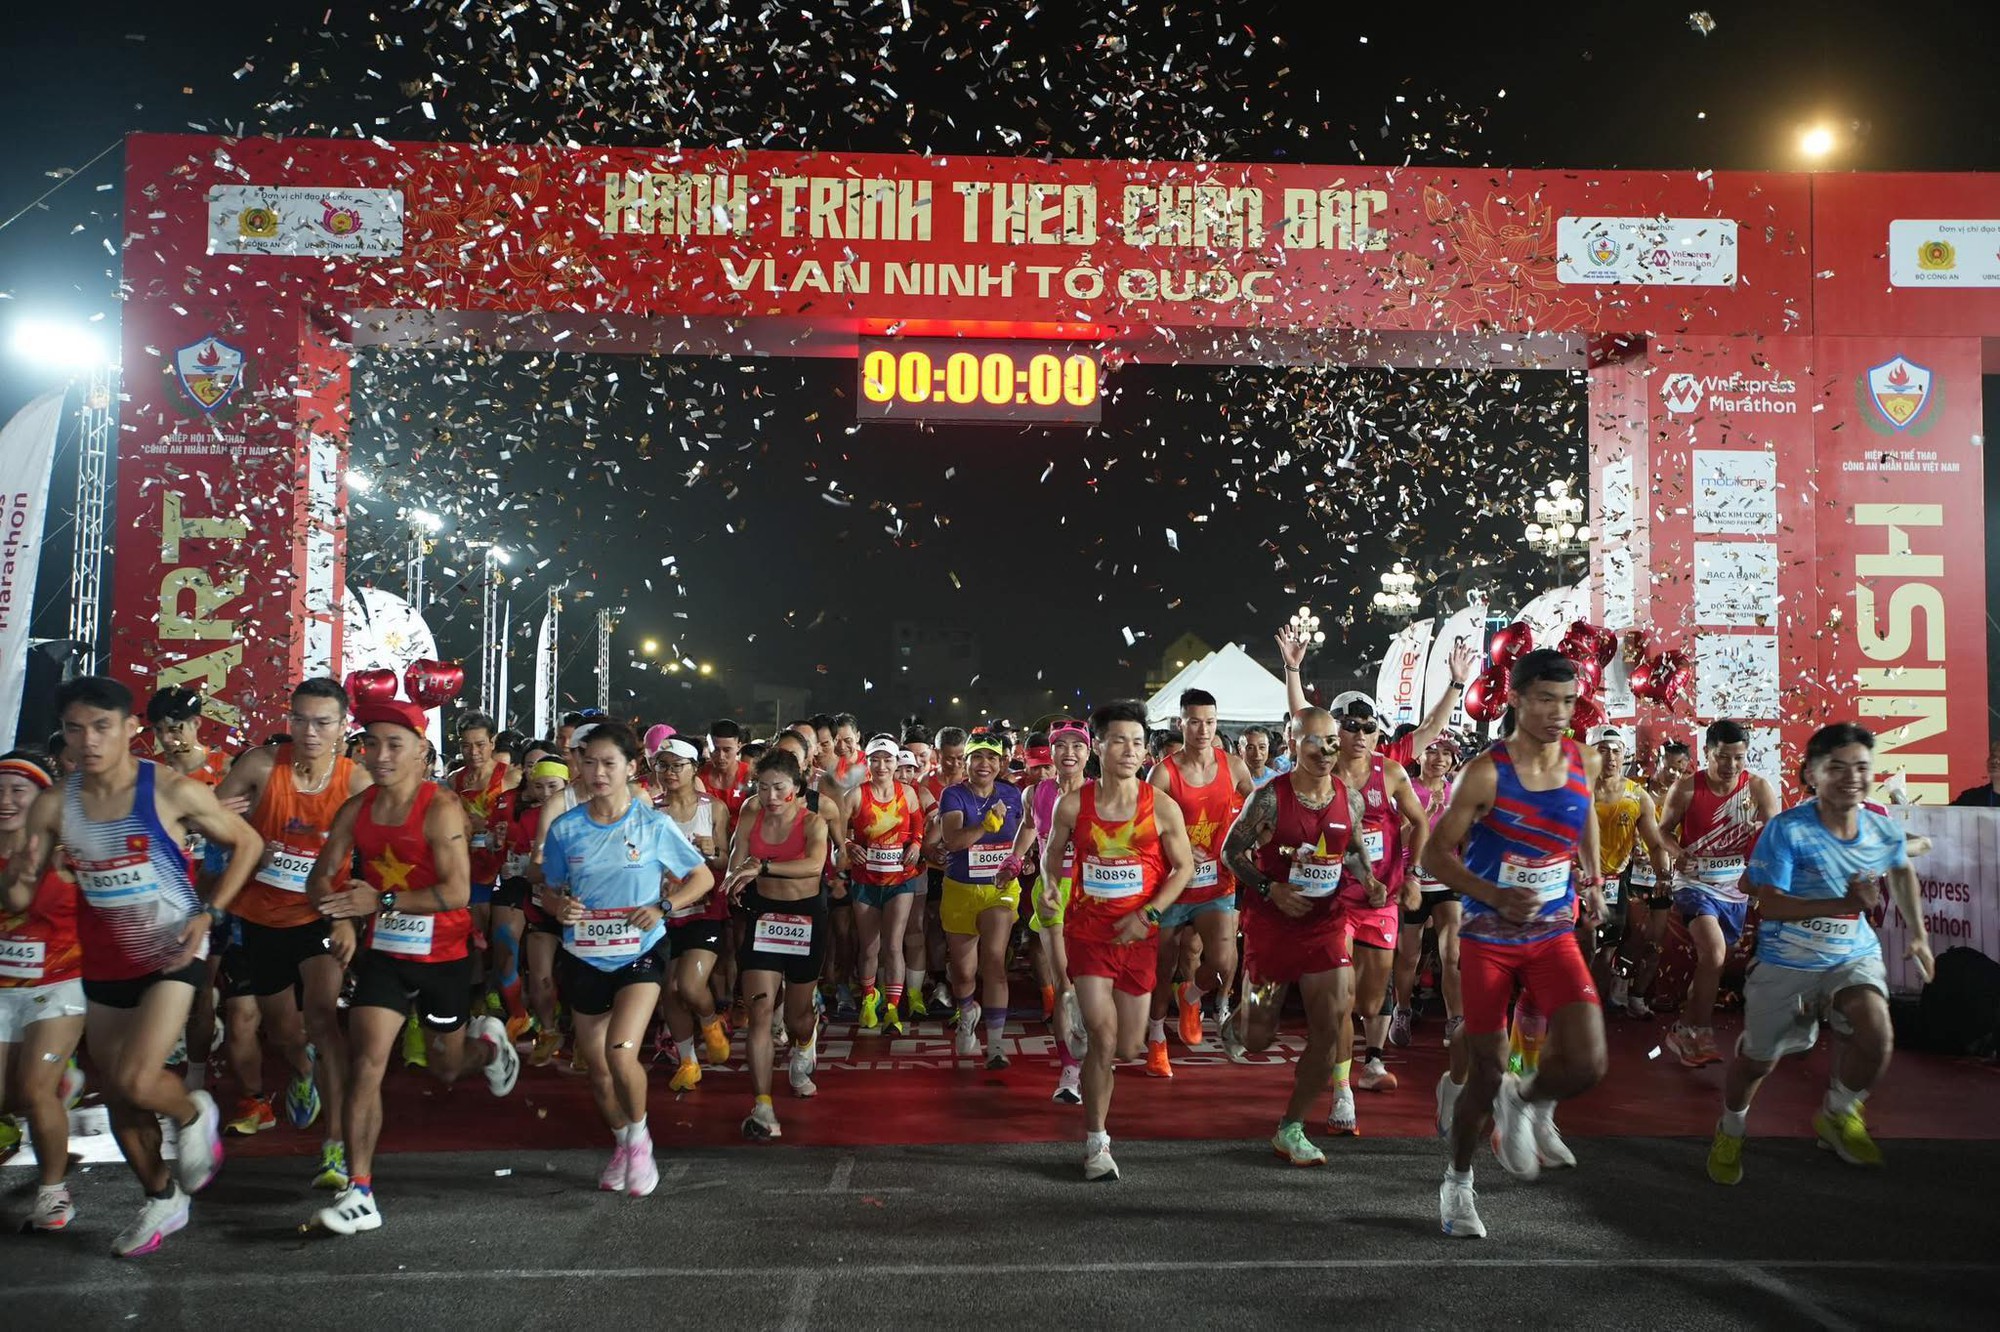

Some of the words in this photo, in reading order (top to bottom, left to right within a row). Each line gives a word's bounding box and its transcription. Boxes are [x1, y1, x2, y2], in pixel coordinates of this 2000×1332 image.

[770, 167, 933, 241] TRÌNH
[952, 181, 1097, 246] THEO
[1284, 178, 1388, 251] BÁC
[789, 260, 870, 294] AN
[884, 262, 1013, 297] NINH
[1026, 252, 1104, 299] TỔ
[1118, 258, 1275, 303] QUỐC
[863, 350, 1097, 406] 00:00:00
[1709, 396, 1797, 414] Marathon
[1866, 462, 1878, 471] AN
[1701, 477, 1768, 489] mobifone
[156, 490, 248, 757] ART
[1854, 503, 1950, 806] INISH
[1393, 651, 1415, 725] bifone
[273, 857, 318, 873] 8026
[979, 853, 1010, 863] 8066
[1709, 858, 1741, 869] 80349
[93, 870, 142, 888] 80124
[1095, 868, 1137, 880] 80896
[1303, 868, 1338, 880] 80365
[384, 917, 427, 933] 80840
[587, 923, 629, 936] 80431
[1801, 918, 1848, 935] 80310
[1895, 905, 1972, 938] Mathon
[768, 925, 805, 938] 80342
